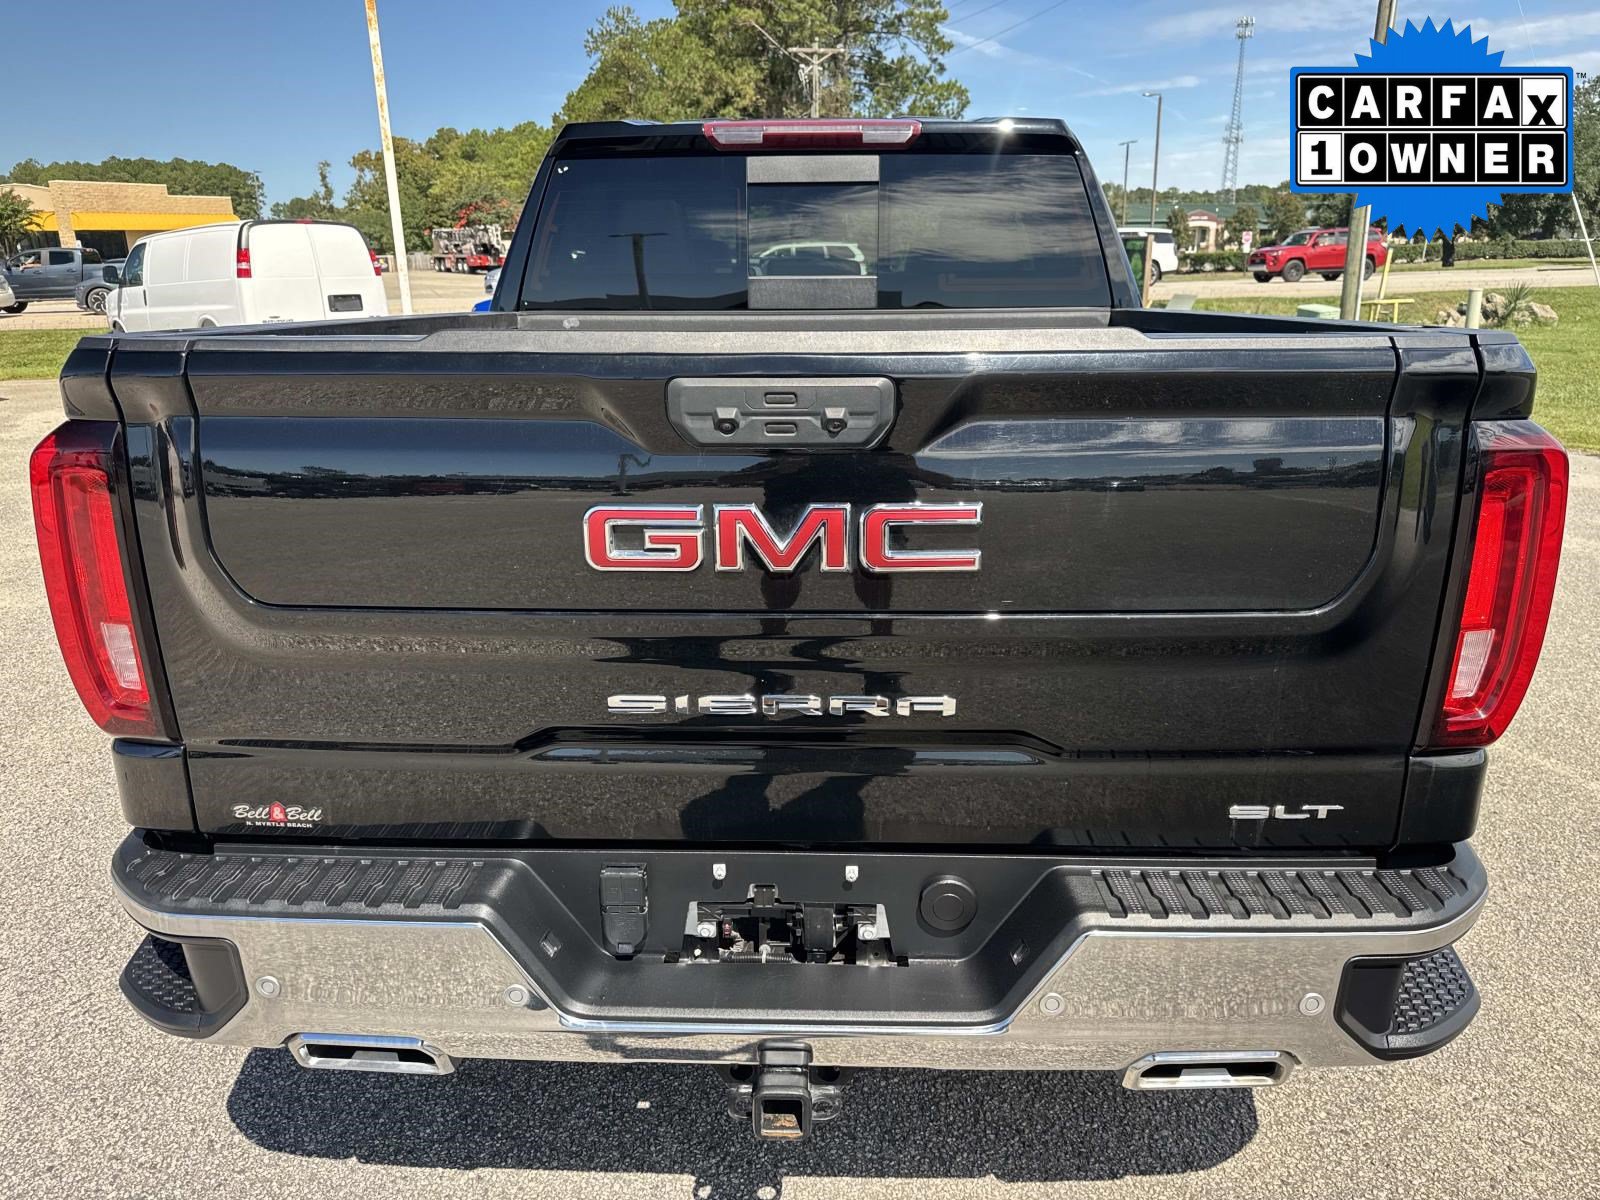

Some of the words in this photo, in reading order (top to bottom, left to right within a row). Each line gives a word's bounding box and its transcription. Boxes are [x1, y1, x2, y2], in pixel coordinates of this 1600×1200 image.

[583, 502, 984, 572] GMC
[607, 694, 957, 717] SIERRA
[233, 805, 269, 819] Bell
[272, 807, 284, 819] &
[286, 807, 322, 821] Bell
[1229, 804, 1345, 820] SLT
